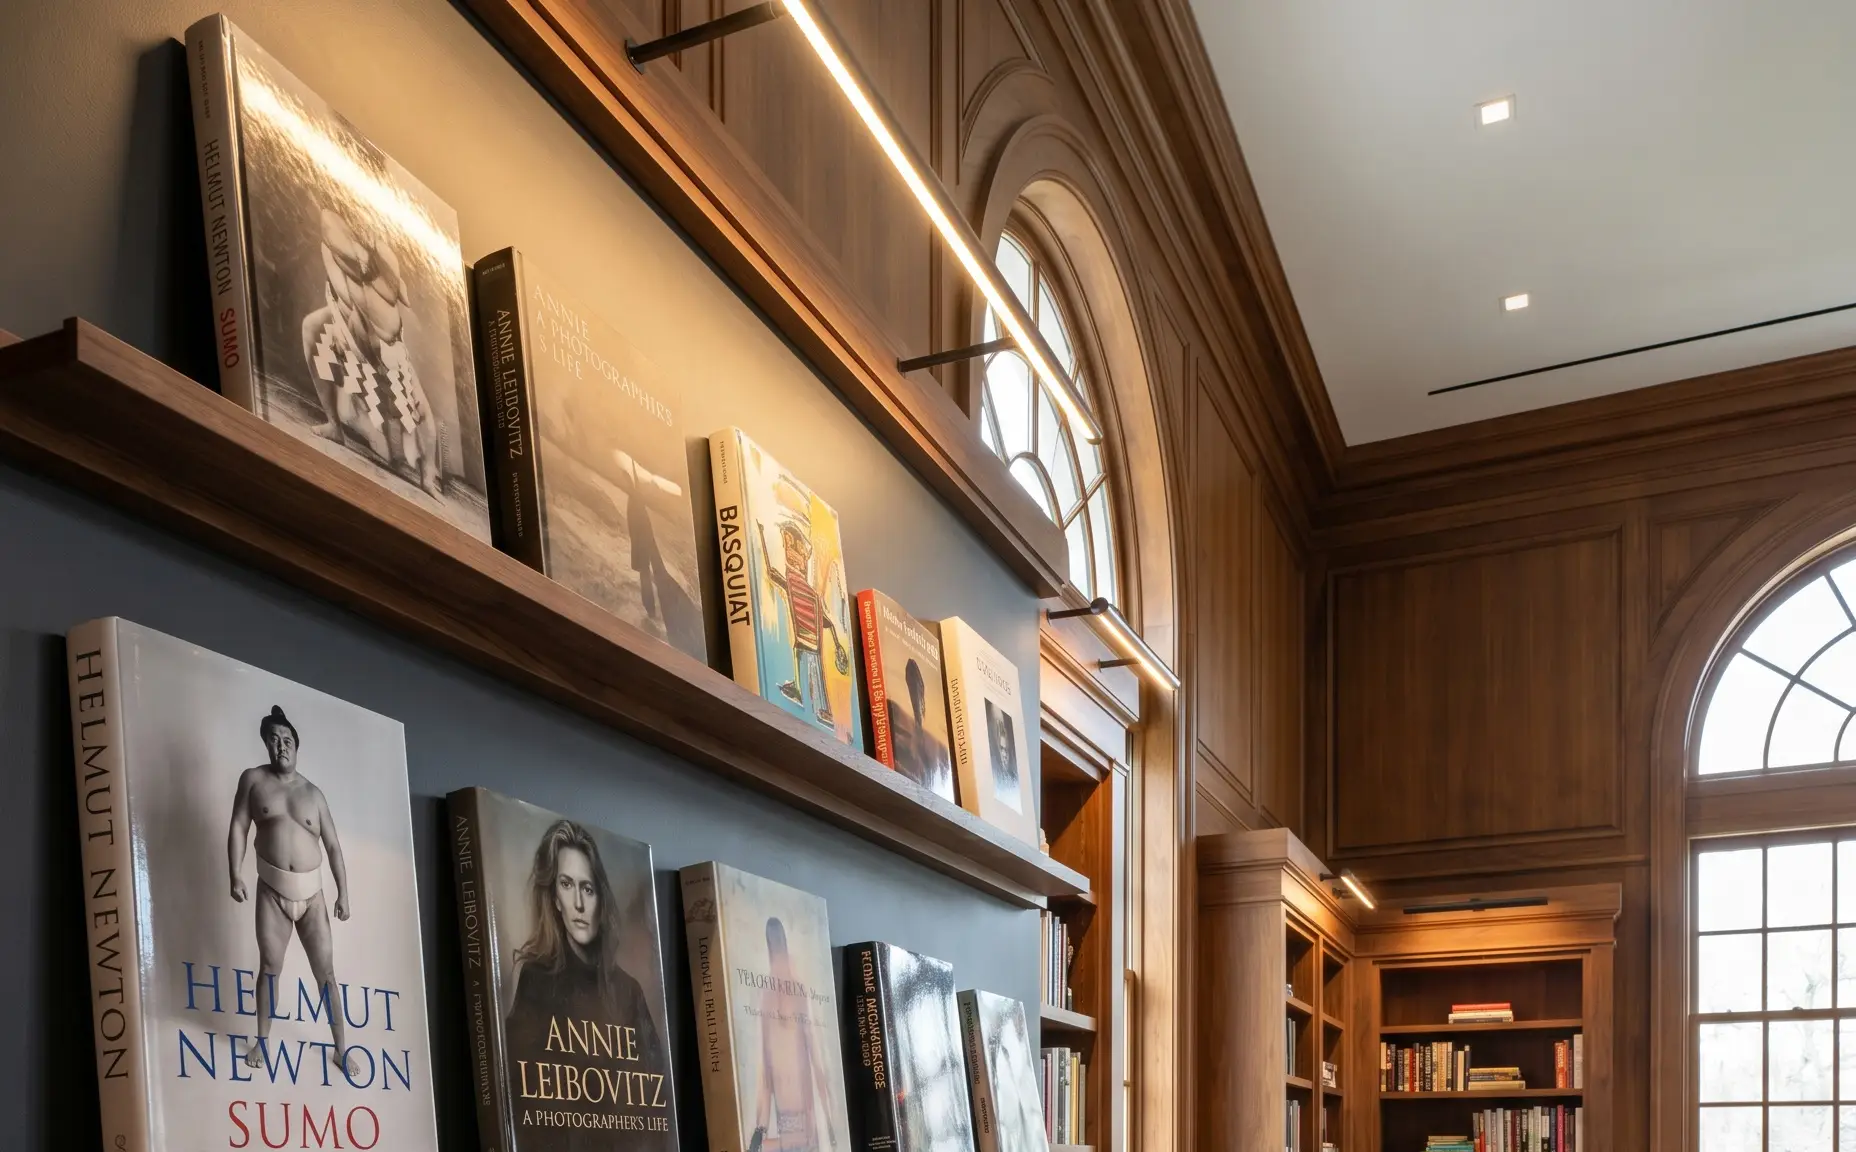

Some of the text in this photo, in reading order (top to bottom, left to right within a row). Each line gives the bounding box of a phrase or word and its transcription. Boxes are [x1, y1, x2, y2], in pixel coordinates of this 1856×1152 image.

[204, 139, 226, 212] HELMUT
[212, 214, 232, 296] NEWTON
[220, 308, 240, 369] SUMO
[497, 309, 515, 365] ANNIE
[534, 285, 590, 341] ANNIE
[553, 343, 582, 379] LIFE
[719, 505, 751, 627] BASQUIAT
[76, 647, 129, 1081] HELMUT NEWTON
[455, 815, 474, 875] ANNIE
[462, 878, 482, 969] LEIBOVITZ
[182, 961, 400, 1032] HELMUT
[177, 1029, 412, 1092] NEWTON
[545, 1016, 640, 1062] ANNIE
[518, 1060, 668, 1108] LEIBOVITZ
[228, 1100, 381, 1151] SUMO
[522, 1110, 669, 1132] A PHOTOGRAPHER'S LIFE
